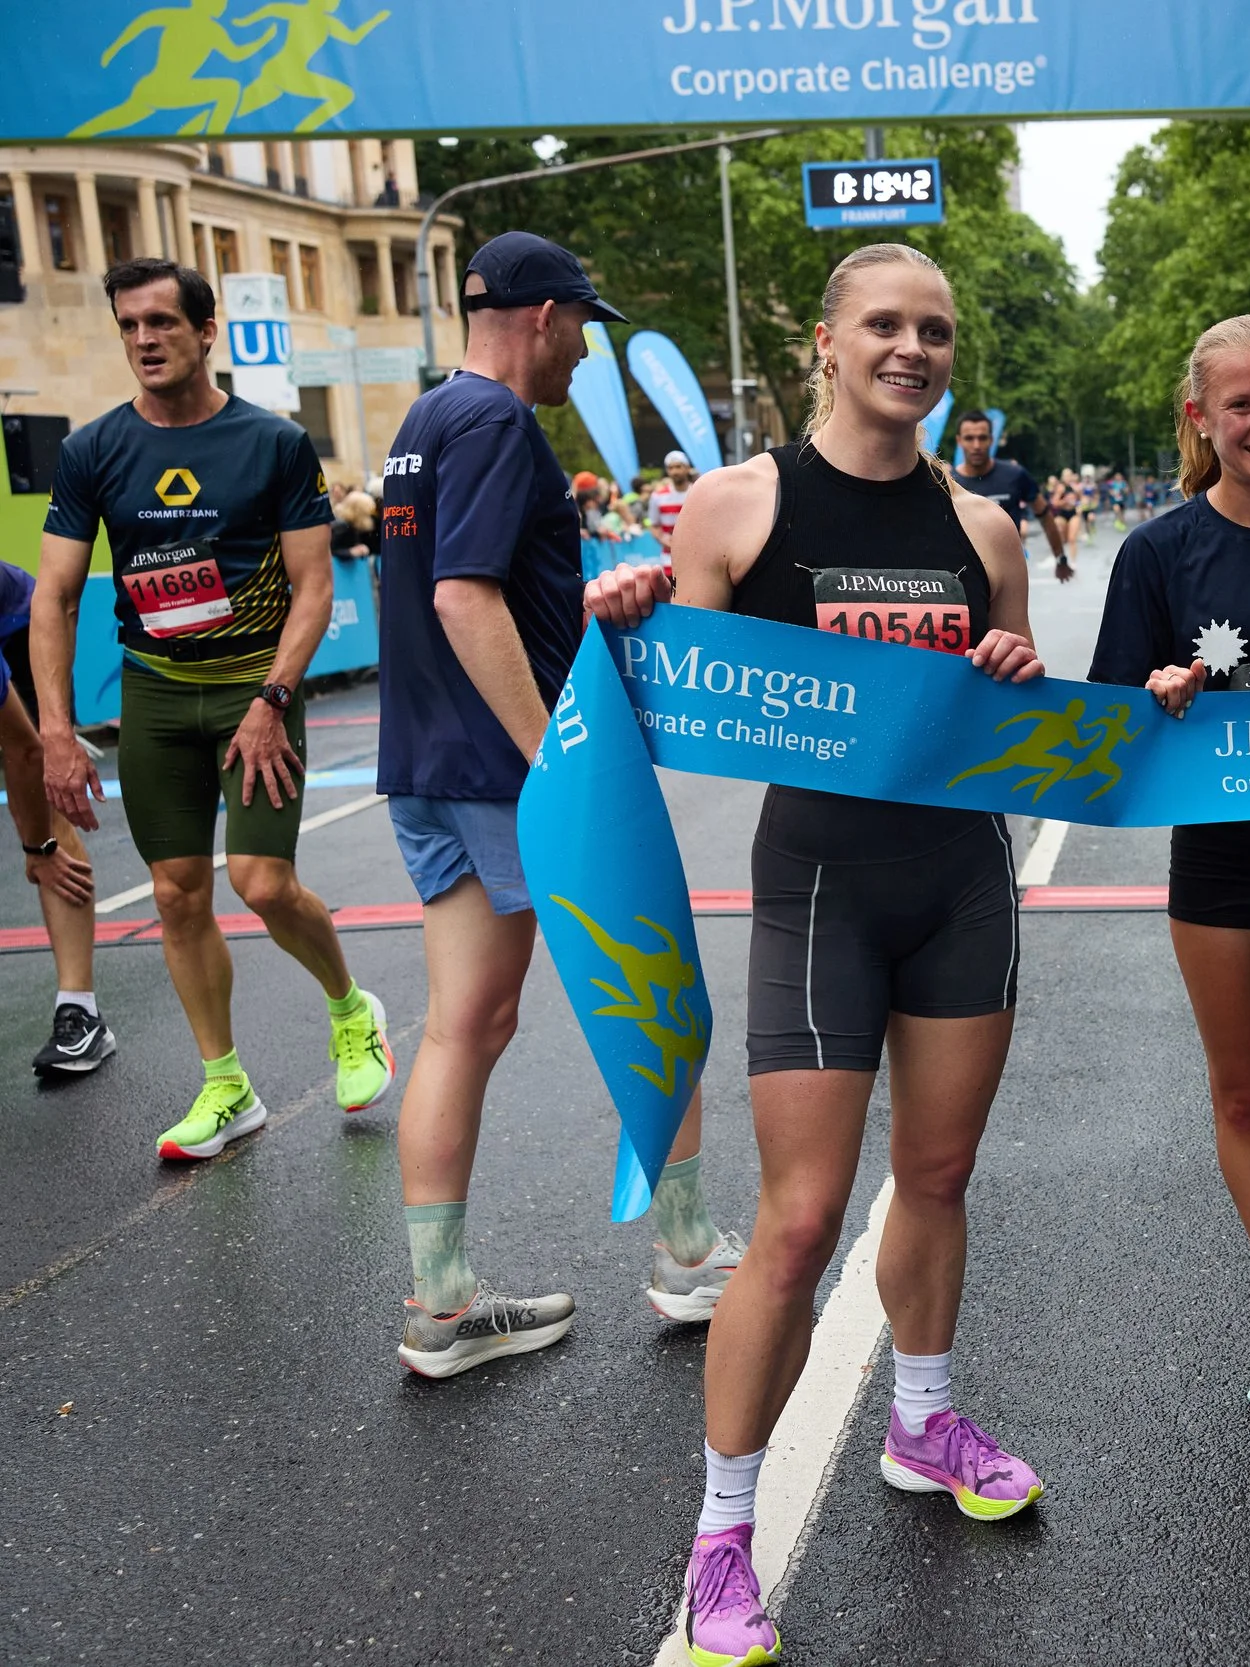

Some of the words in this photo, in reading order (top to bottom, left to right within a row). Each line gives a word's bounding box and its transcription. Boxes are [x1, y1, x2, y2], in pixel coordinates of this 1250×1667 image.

[663, 0, 1039, 49] J.P.Morgan
[671, 65, 850, 100] Corporate
[841, 208, 907, 222] FRANKFURT
[232, 323, 269, 363] U
[138, 509, 219, 519] COMMERZBANK
[131, 546, 196, 567] J.P.Morgan
[131, 566, 216, 601] 11686
[837, 574, 945, 598] J.P.Morgan
[830, 611, 964, 649] 10545
[456, 1308, 538, 1336] BROOKS
